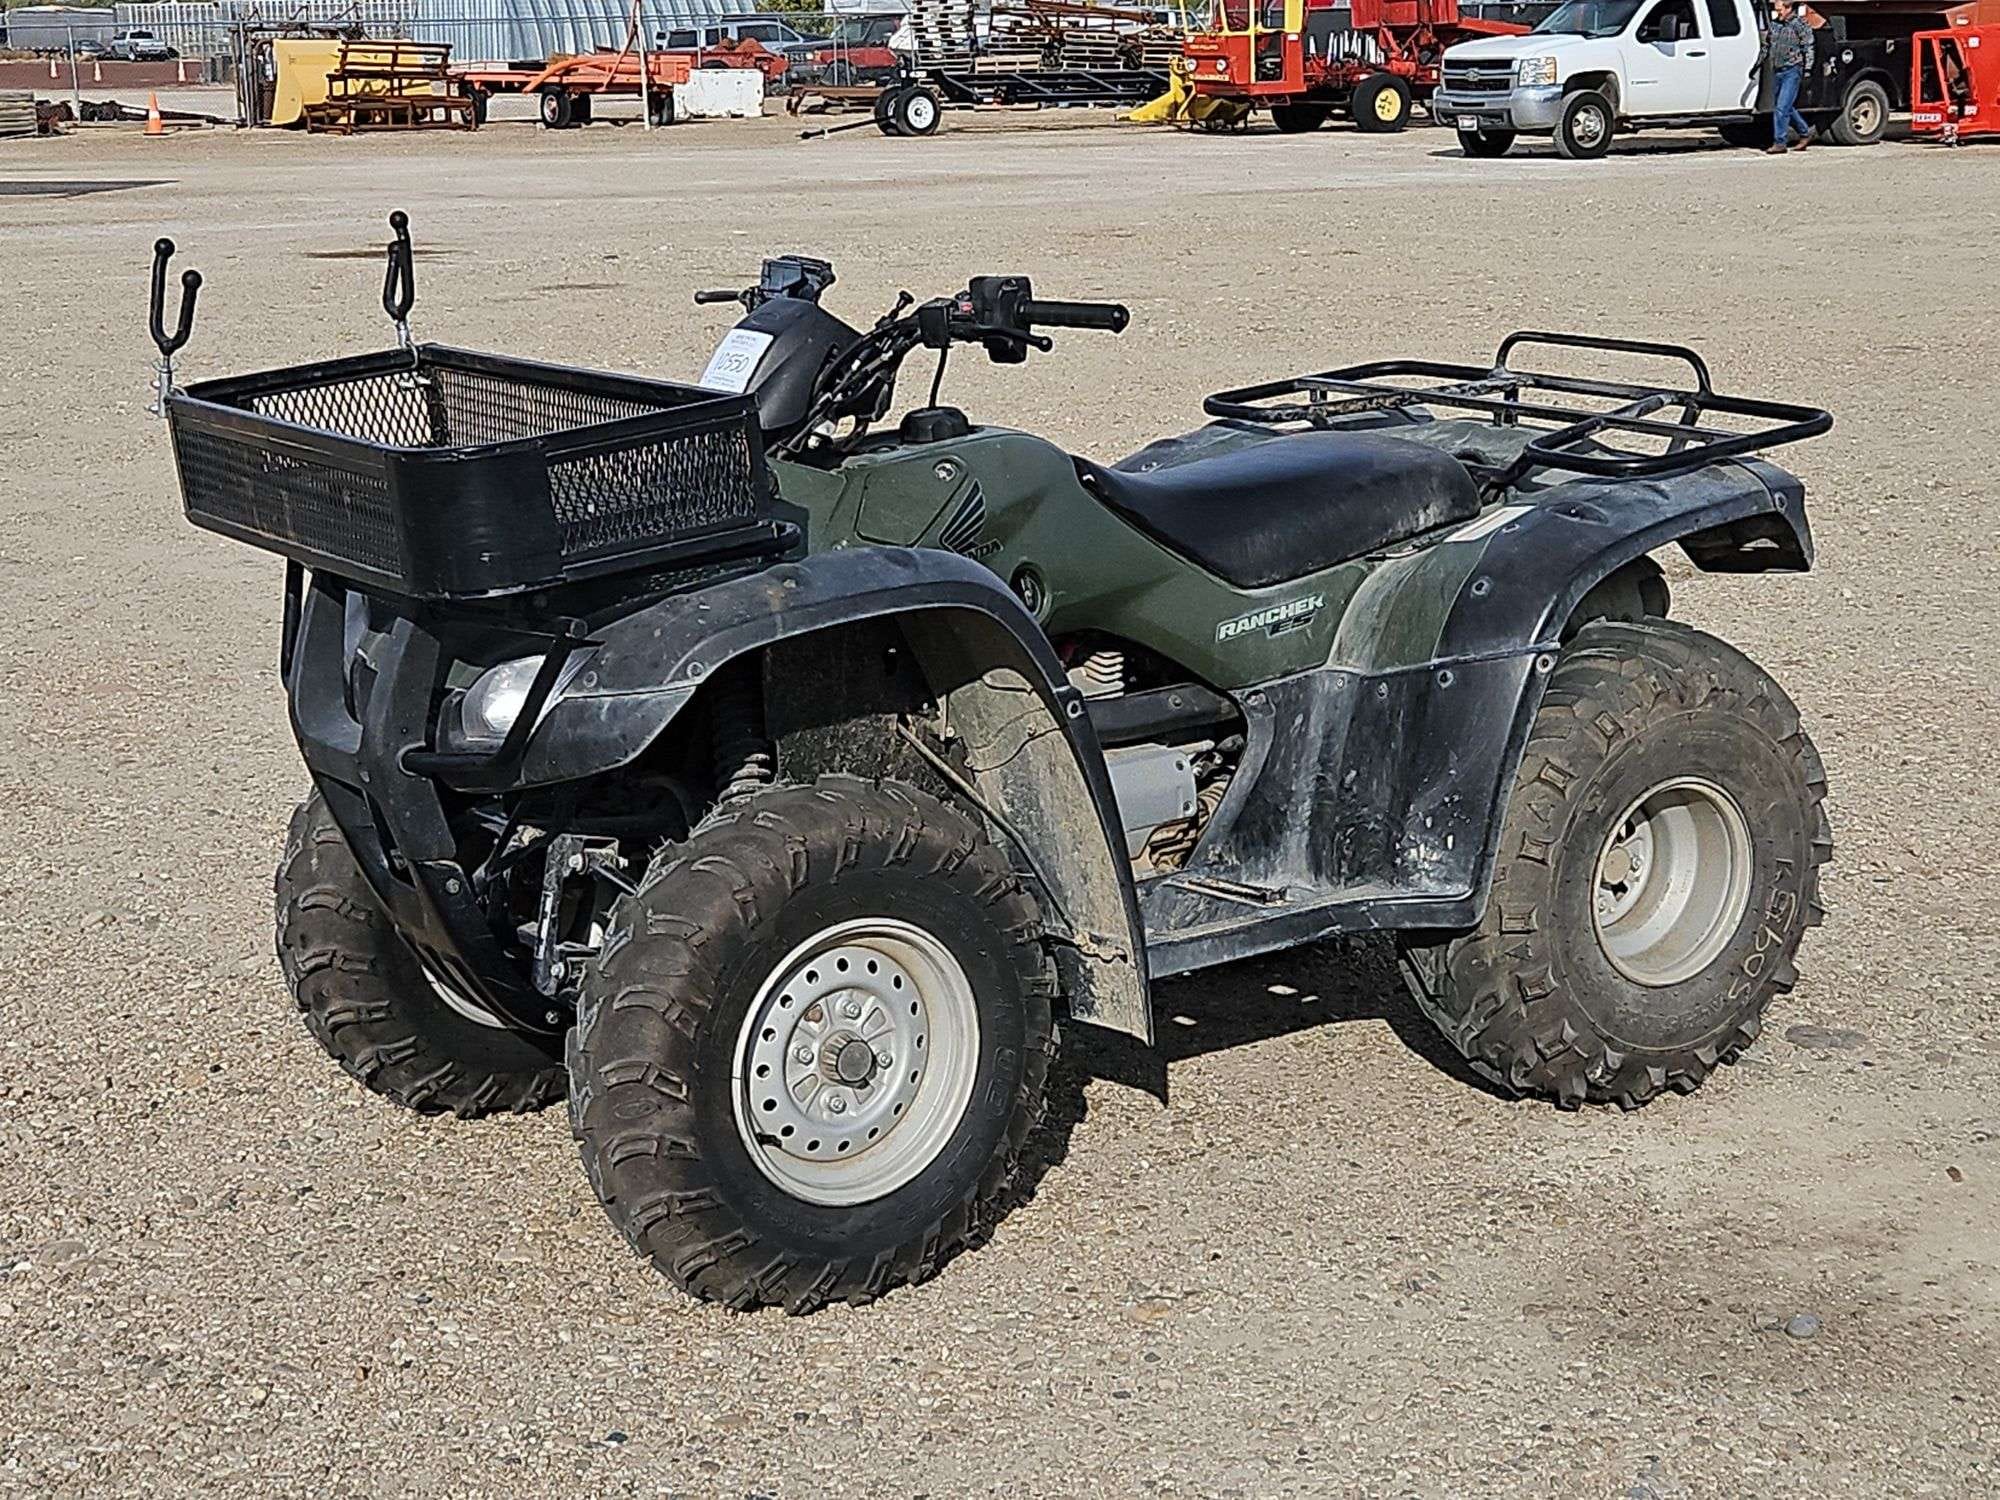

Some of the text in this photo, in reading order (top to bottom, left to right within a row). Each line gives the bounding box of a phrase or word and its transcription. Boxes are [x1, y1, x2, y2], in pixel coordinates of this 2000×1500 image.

[964, 540, 1002, 560] NDA
[1218, 594, 1326, 640] RANCHER
[1269, 614, 1315, 636] ES
